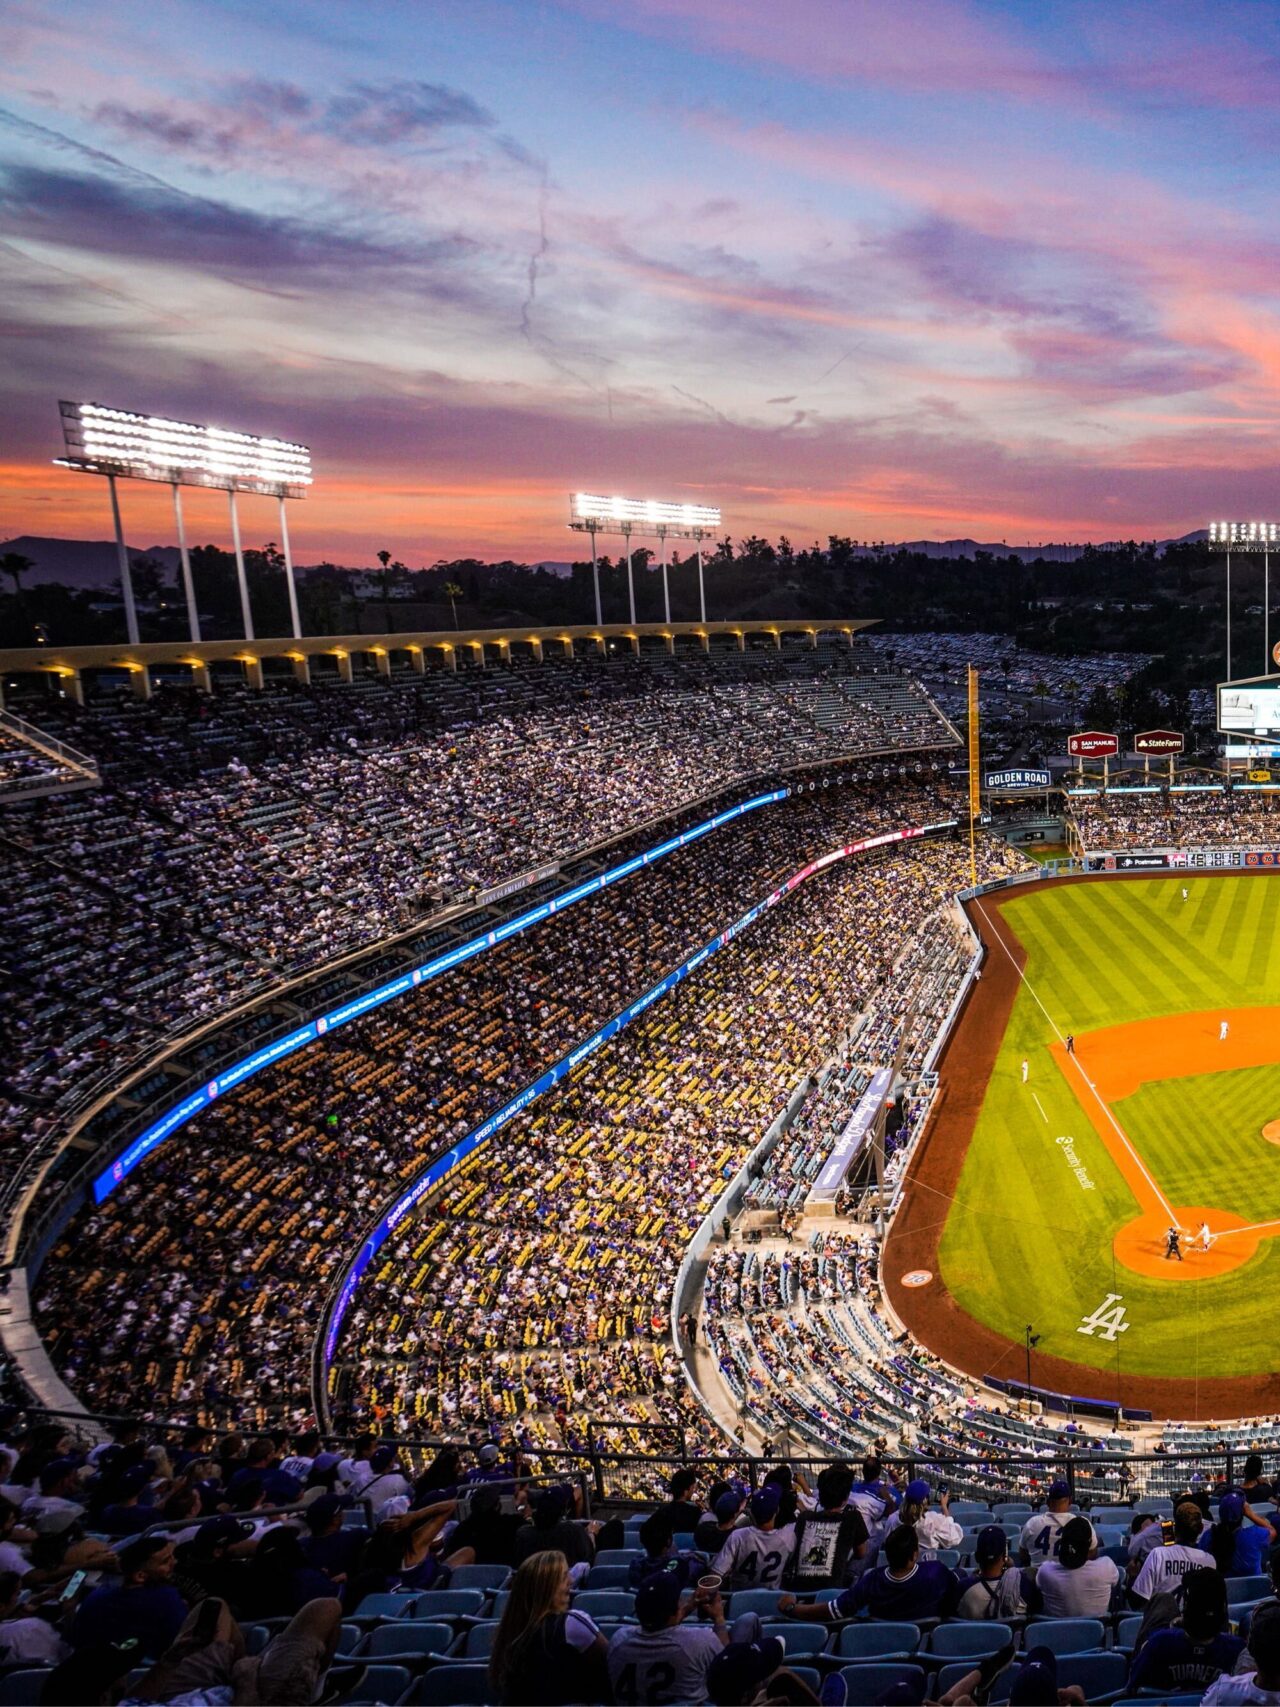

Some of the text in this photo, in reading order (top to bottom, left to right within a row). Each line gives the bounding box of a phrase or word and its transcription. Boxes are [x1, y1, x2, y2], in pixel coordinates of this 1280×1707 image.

[988, 772, 1047, 786] GOLDEN ROAD
[569, 1044, 590, 1066] Spectrum
[474, 1124, 492, 1142] SPEED
[496, 1099, 525, 1125] RELIABILITY
[1062, 1144, 1096, 1190] Security Benefit
[387, 1192, 416, 1228] Spectrum
[1077, 1293, 1130, 1341] LA
[740, 1551, 782, 1582] 42
[615, 1662, 676, 1702] 42
